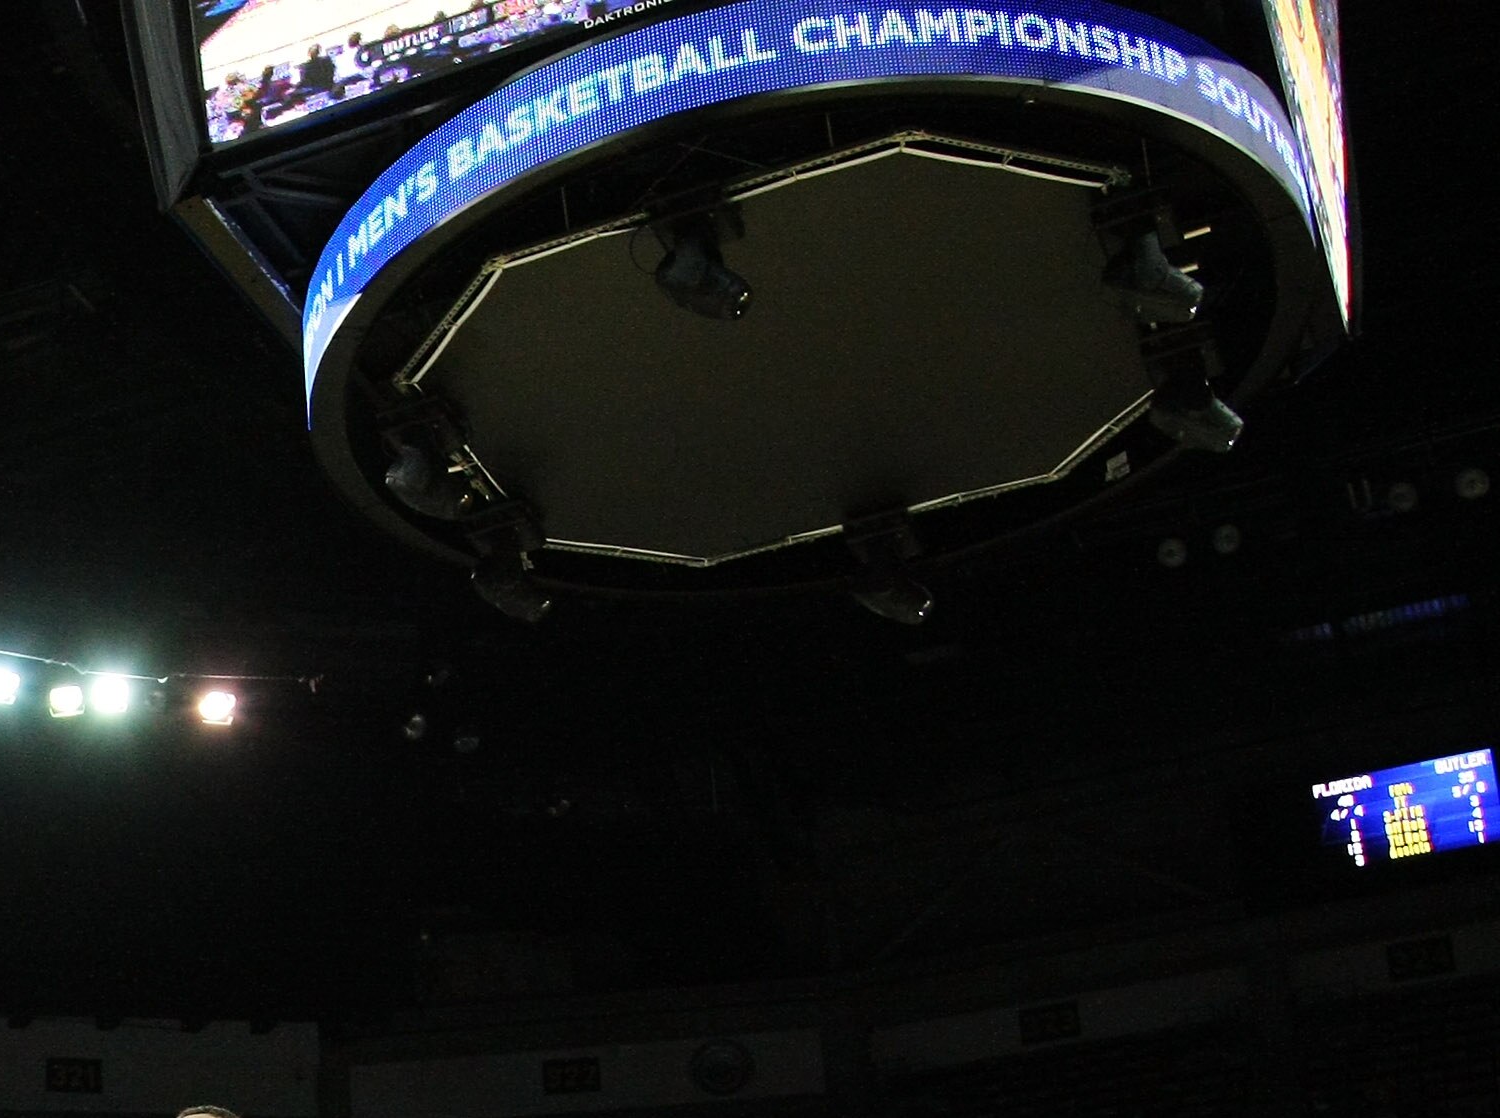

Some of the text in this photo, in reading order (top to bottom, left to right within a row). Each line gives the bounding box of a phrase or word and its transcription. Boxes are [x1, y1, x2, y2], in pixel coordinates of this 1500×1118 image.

[347, 160, 439, 269] MEN'S
[447, 27, 779, 182] BASKETBALL
[793, 8, 1188, 84] CHAMPIONSHIP
